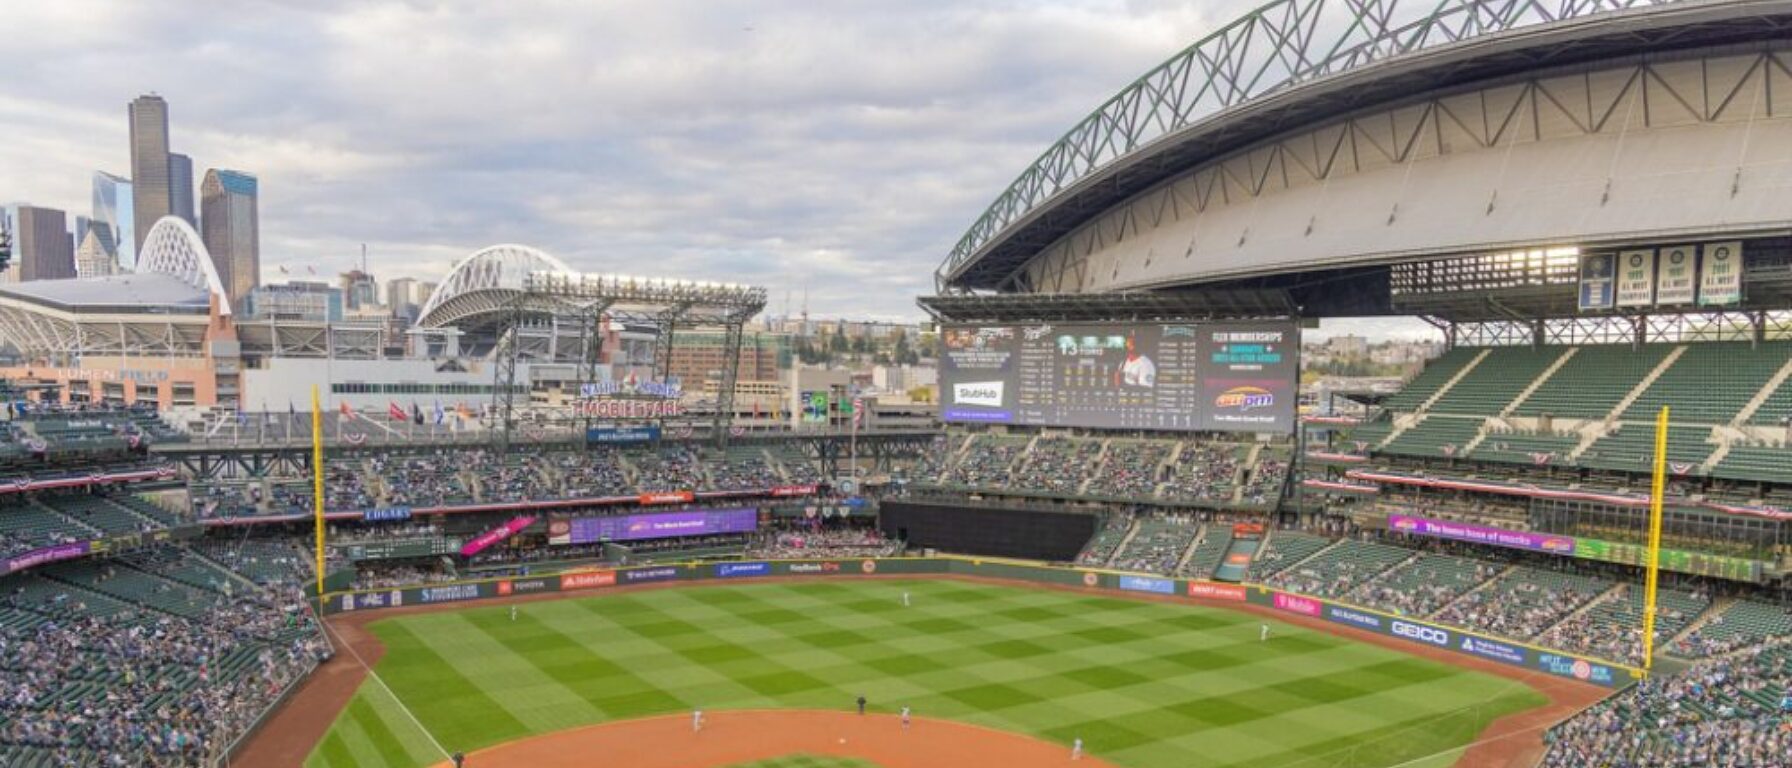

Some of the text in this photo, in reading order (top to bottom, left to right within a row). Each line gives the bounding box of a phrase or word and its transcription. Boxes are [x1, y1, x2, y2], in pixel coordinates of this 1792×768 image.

[960, 388, 997, 399] StubHub
[514, 581, 545, 590] TOYOTA
[1392, 620, 1448, 645] GEICO
